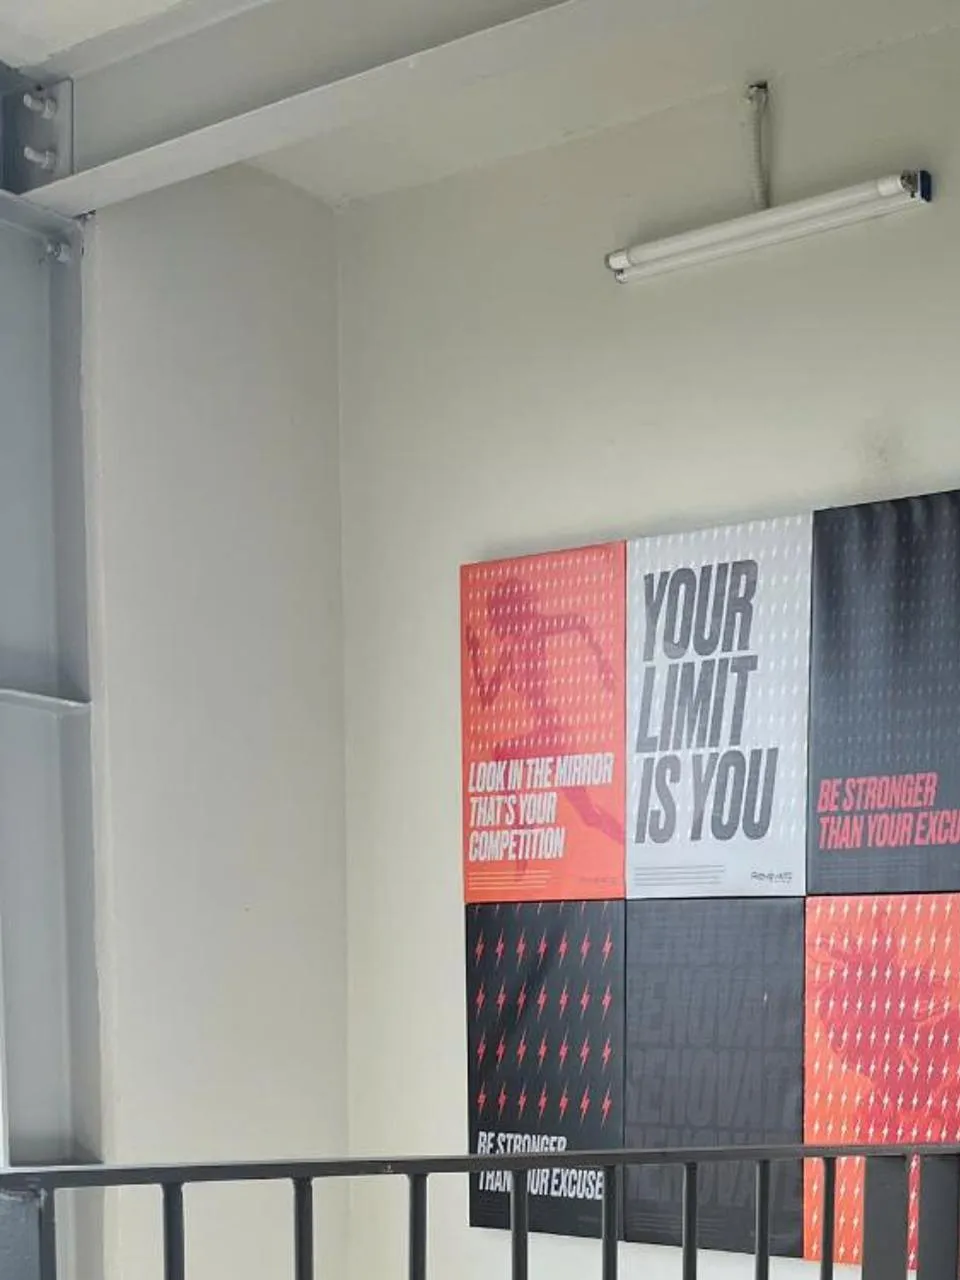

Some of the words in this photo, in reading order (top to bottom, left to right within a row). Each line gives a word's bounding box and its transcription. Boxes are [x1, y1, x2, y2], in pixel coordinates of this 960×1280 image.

[642, 559, 758, 662] YOUR
[636, 655, 758, 753] LIMIT
[468, 760, 507, 792] LOOK
[507, 759, 524, 790] IN
[525, 757, 554, 789] THE
[554, 752, 615, 787] MIRROR
[469, 794, 517, 828] THAT'S
[519, 792, 557, 825] YOUR
[634, 754, 681, 844] IS
[690, 747, 779, 841] YOU
[817, 778, 842, 813] BE
[842, 772, 939, 811] STRONGER
[468, 827, 566, 862] COMPETITION
[818, 814, 864, 849] THAN
[867, 811, 914, 848] YOUR
[550, 1167, 605, 1200] EXCUSE
